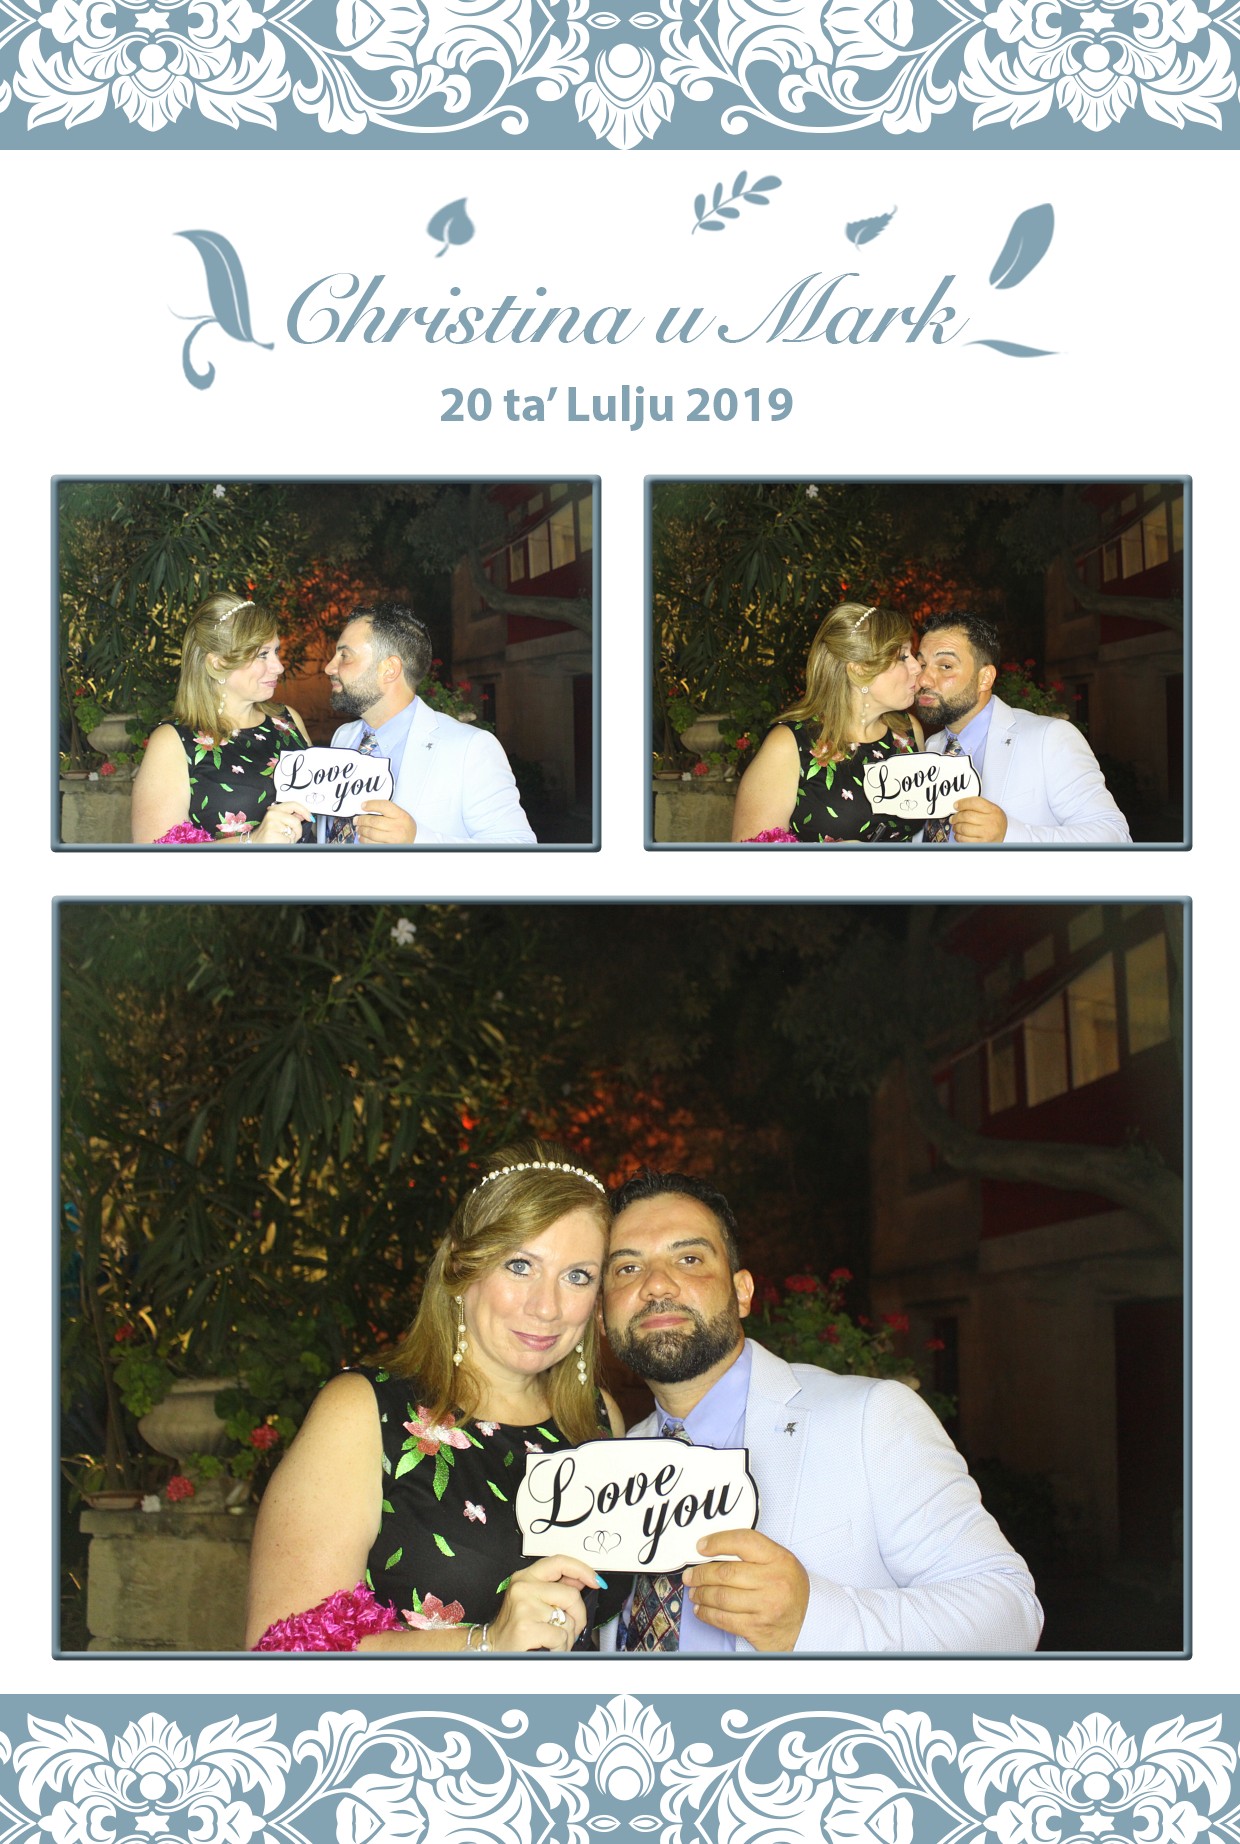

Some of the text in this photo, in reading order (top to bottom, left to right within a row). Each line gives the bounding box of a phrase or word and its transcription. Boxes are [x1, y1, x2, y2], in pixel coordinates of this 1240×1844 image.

[280, 753, 358, 792] Love
[331, 774, 387, 813] you
[866, 764, 941, 804] Love
[926, 772, 972, 816] you
[527, 1456, 684, 1535] Love
[637, 1481, 744, 1566] you
